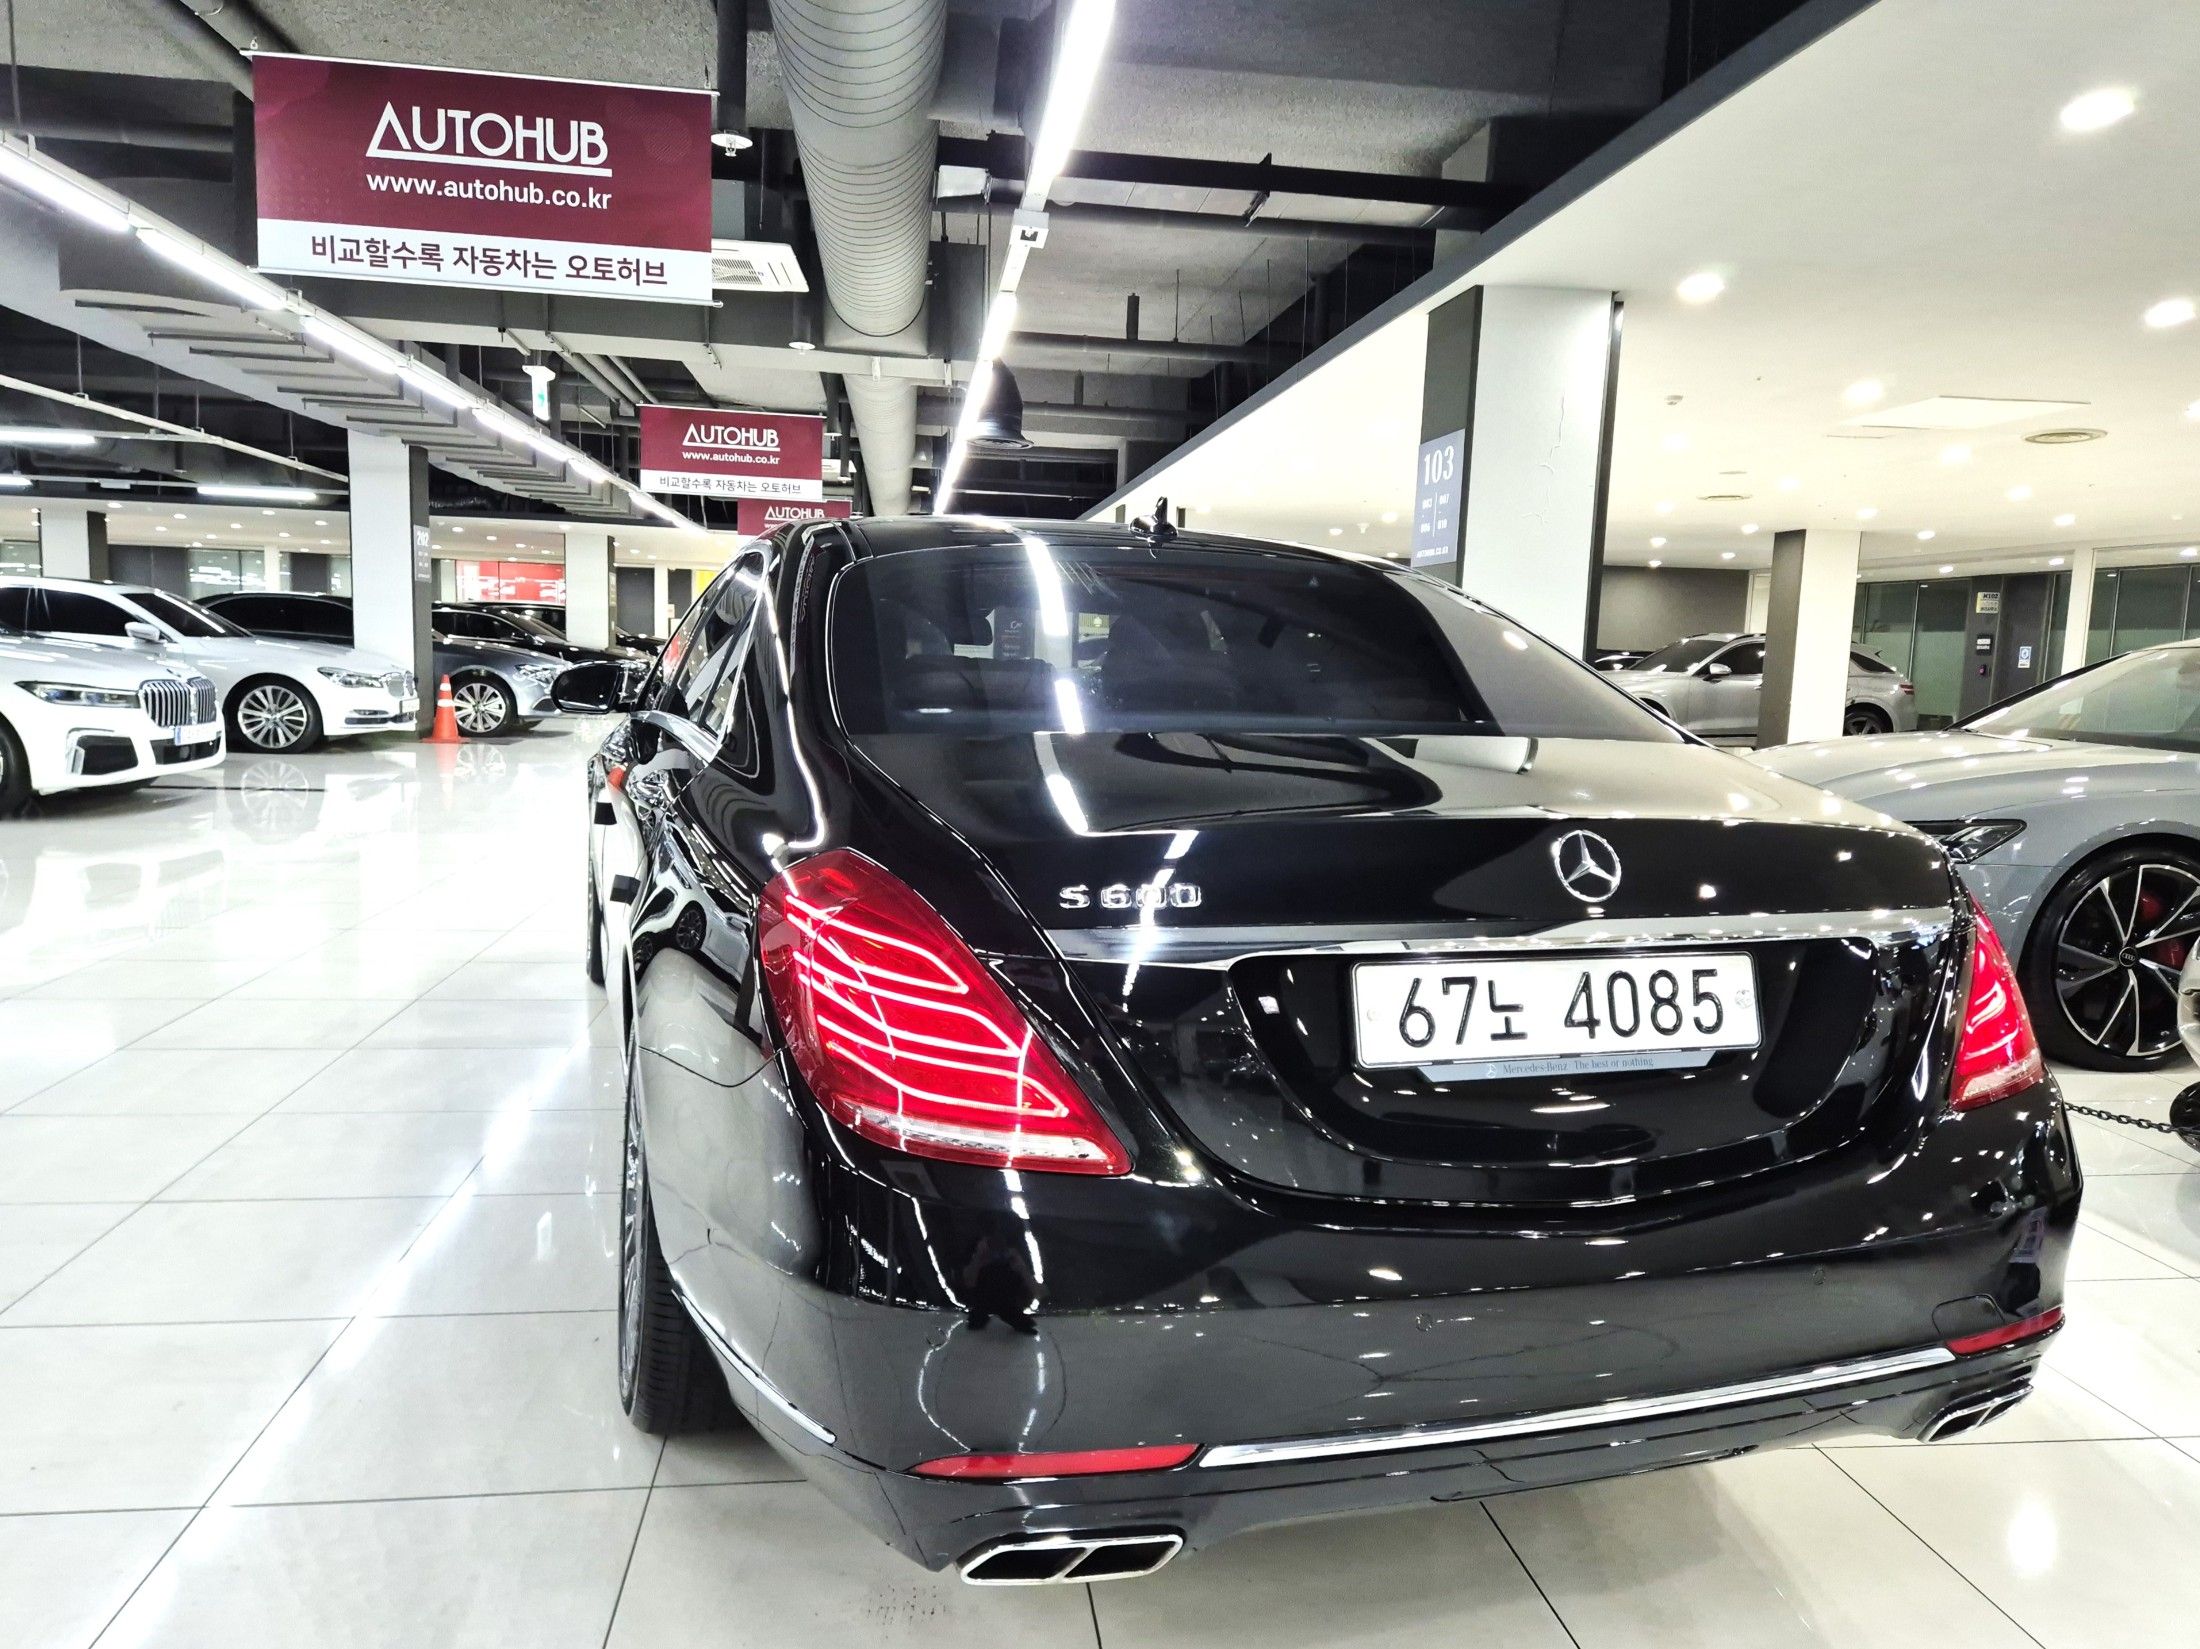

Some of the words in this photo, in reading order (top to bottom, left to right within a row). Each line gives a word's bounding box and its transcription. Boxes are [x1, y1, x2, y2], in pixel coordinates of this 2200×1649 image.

[365, 101, 610, 168] AUTOHUB
[366, 173, 612, 210] www.autohub.co.kr
[311, 234, 444, 271] 비교할수록
[452, 245, 557, 279] 자동차는
[565, 255, 667, 286] 오토허브
[682, 423, 779, 448] AUTOHUB
[682, 451, 780, 465] www.autohub.co.kr
[1424, 445, 1455, 486] 103
[659, 476, 712, 490] 비교할수록
[716, 478, 757, 493] 자동차는
[760, 482, 802, 494] 오토허브
[764, 506, 825, 520] AUTOHUB
[1059, 884, 1091, 909] S
[1100, 883, 1202, 909] 600
[1399, 976, 1528, 1048] 67노
[1563, 968, 1724, 1040] 4085
[1574, 1060, 1589, 1071] The
[1591, 1059, 1609, 1069] best
[1611, 1060, 1620, 1068] or
[1622, 1058, 1654, 1069] nothing
